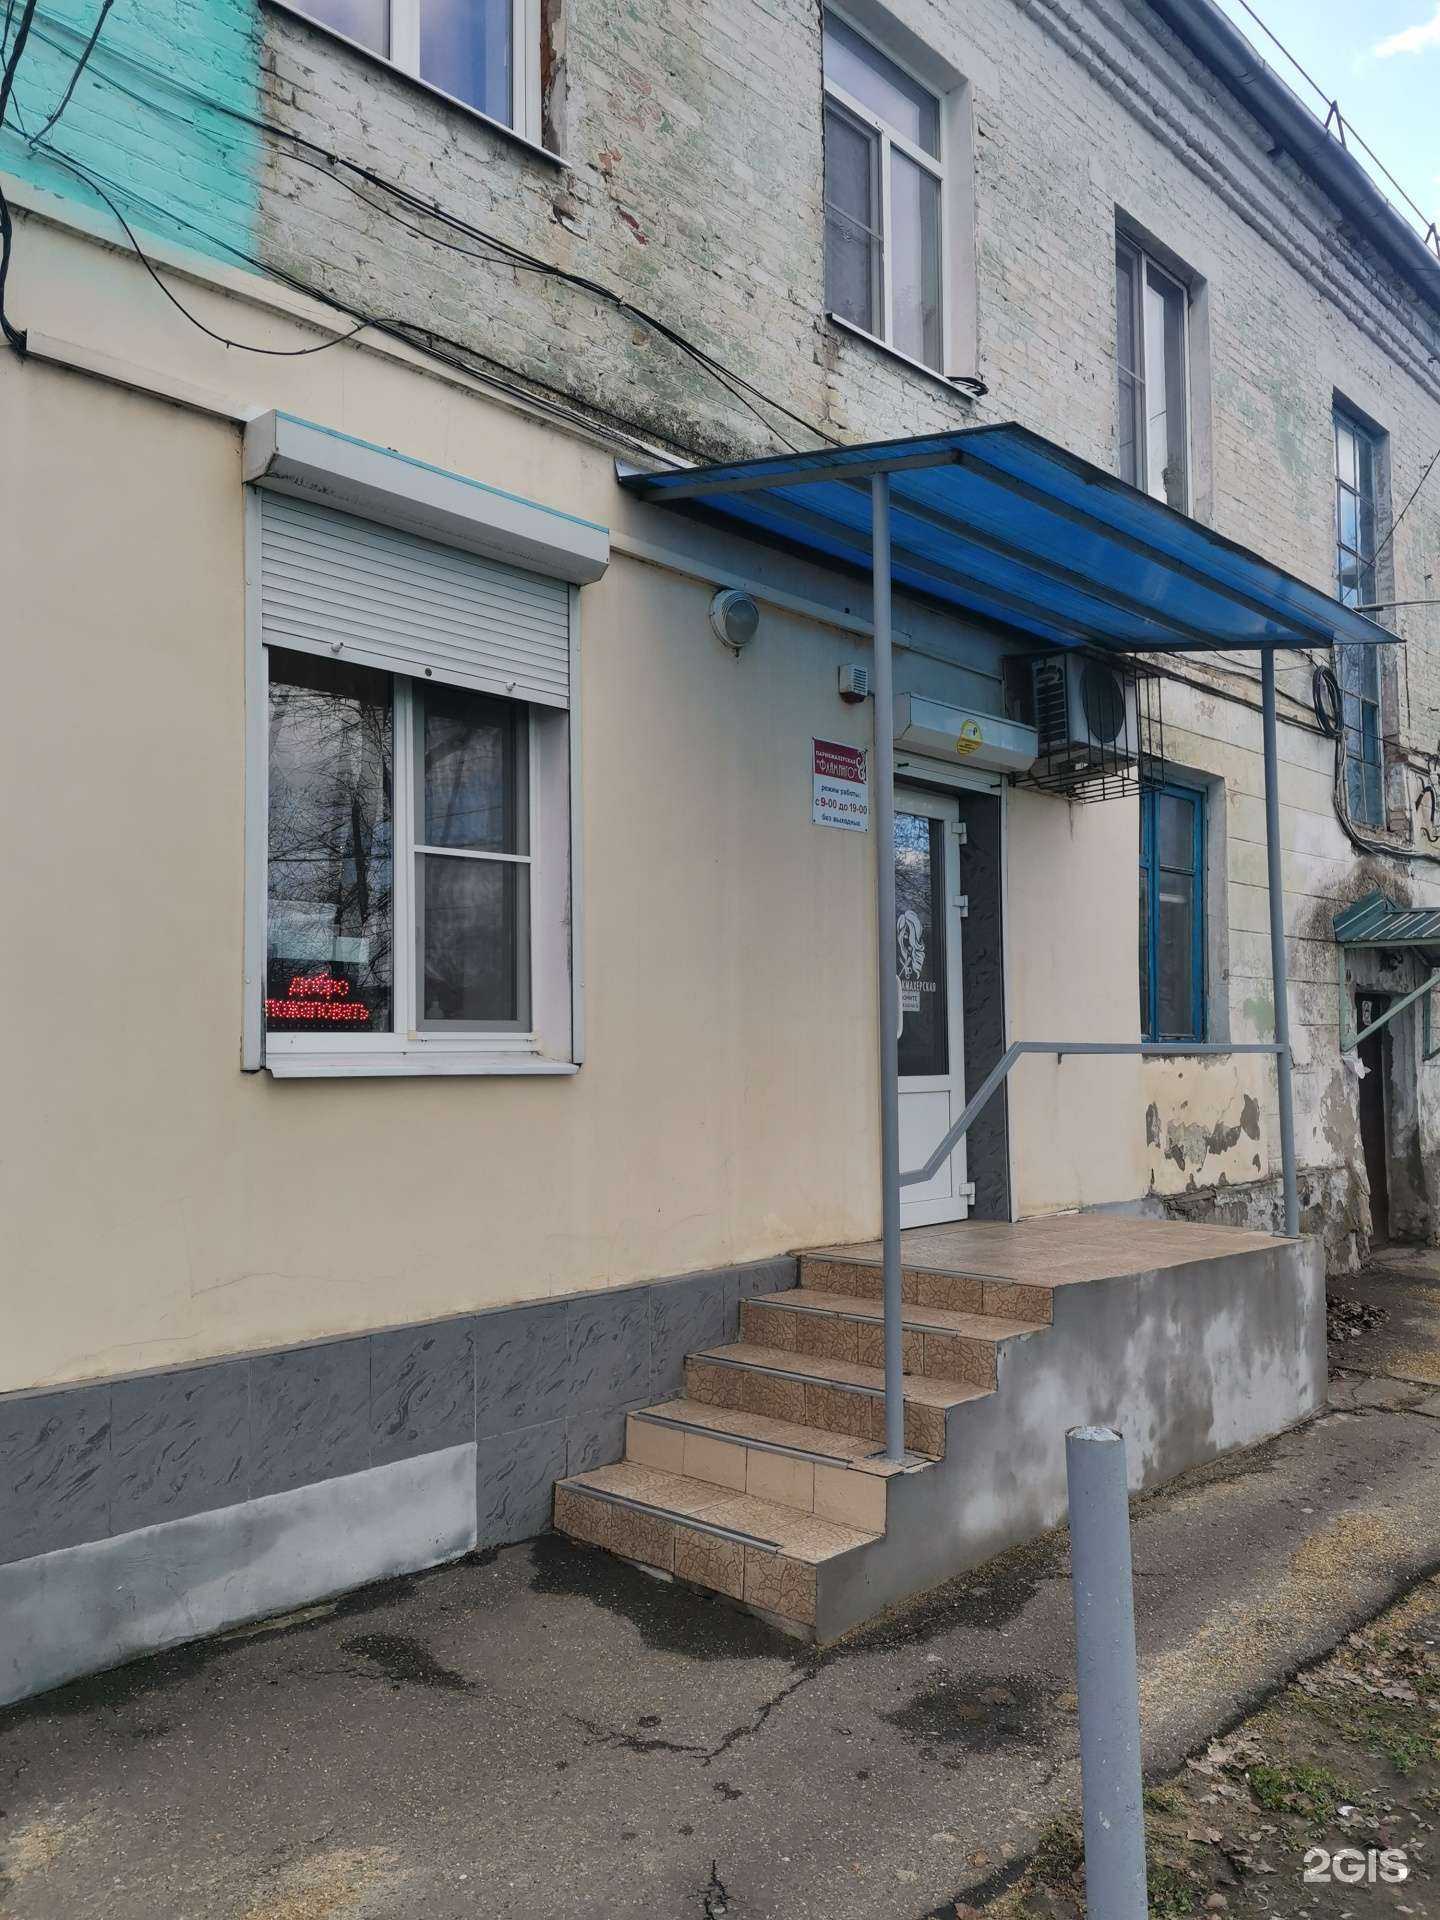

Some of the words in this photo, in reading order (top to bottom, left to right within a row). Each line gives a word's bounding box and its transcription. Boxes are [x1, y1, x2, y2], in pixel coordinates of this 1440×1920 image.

[820, 797, 837, 809] 9-00
[838, 803, 848, 811] до
[849, 802, 868, 815] 19-00
